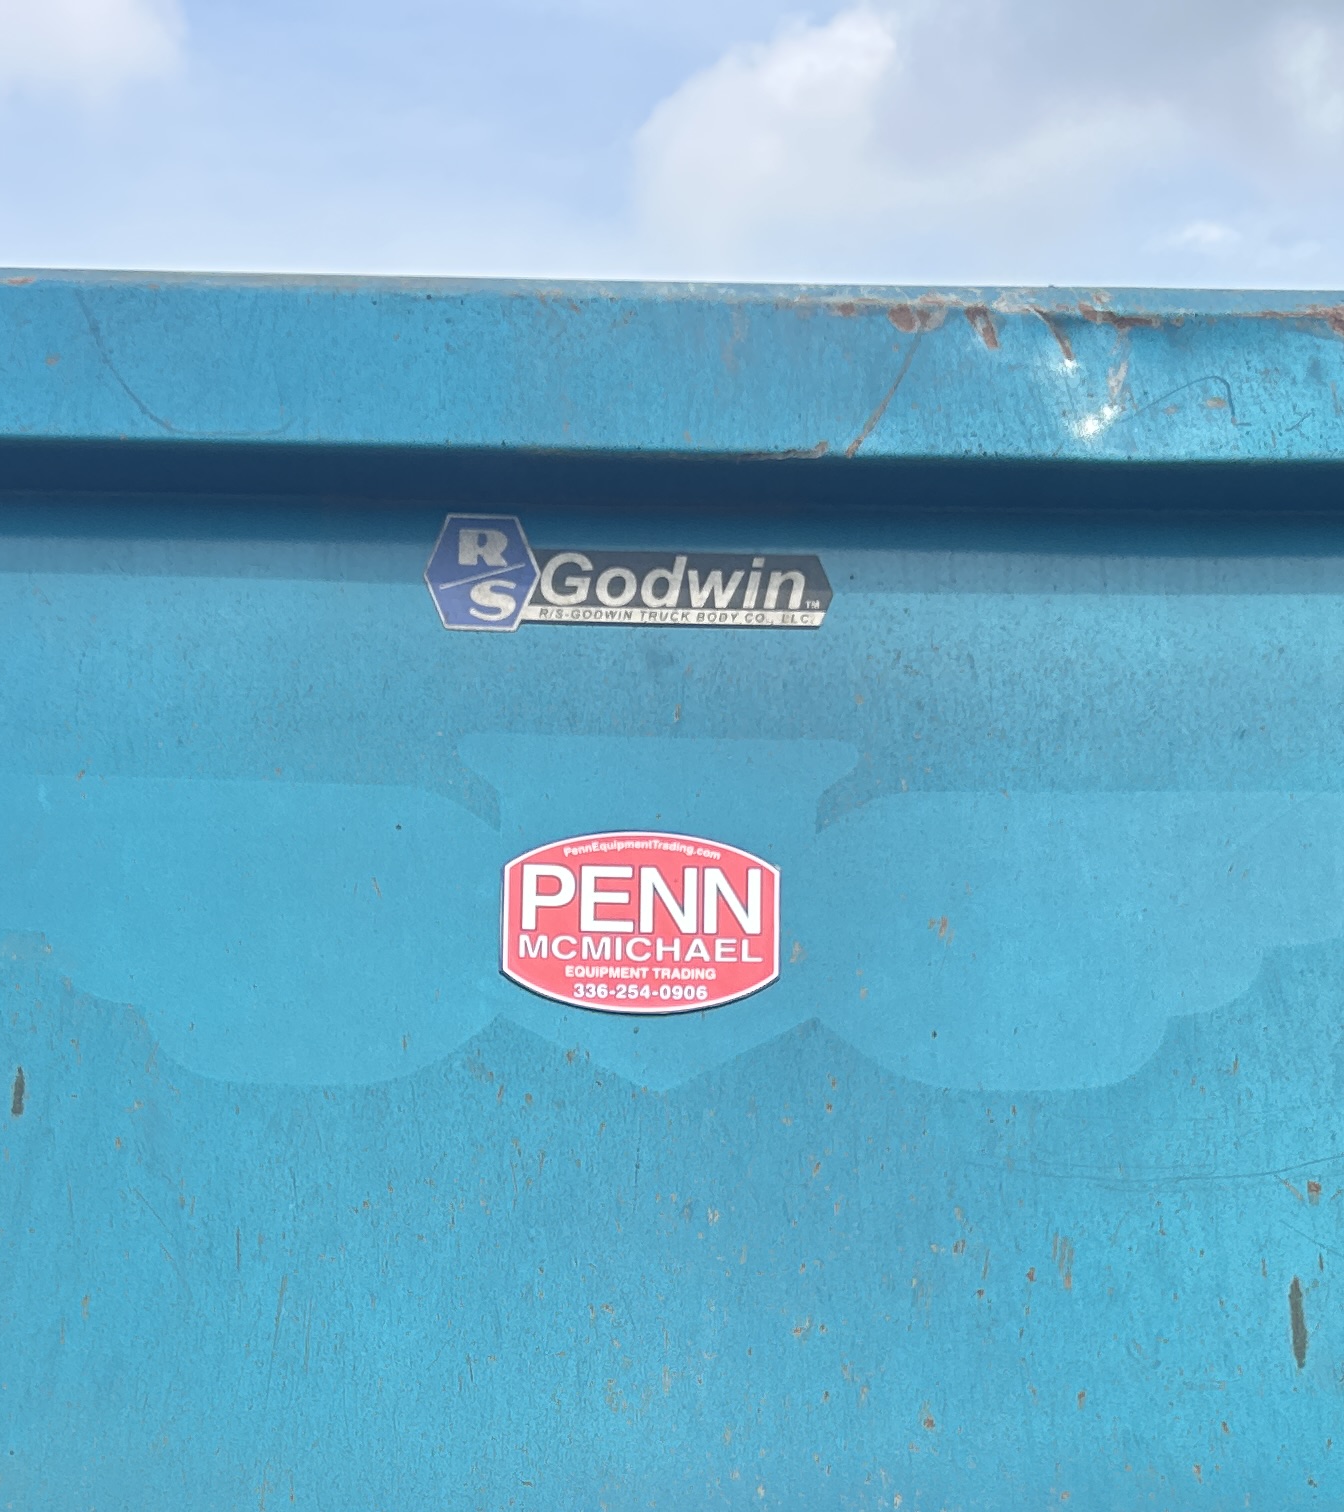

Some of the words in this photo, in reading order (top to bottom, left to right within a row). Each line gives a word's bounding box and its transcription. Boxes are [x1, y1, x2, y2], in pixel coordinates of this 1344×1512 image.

[458, 528, 508, 568] R
[539, 552, 807, 610] Godwin
[469, 579, 517, 621] S
[539, 607, 633, 621] R/S-GODWIN
[640, 610, 690, 622] TRUCK
[696, 611, 739, 624] BODY
[563, 839, 721, 861] PennEquipmentTrading.com
[520, 863, 762, 935] PENN
[517, 934, 763, 963] MCMICHAEL
[564, 965, 649, 979] EQUIPMENT
[652, 967, 717, 980] TRADING
[572, 983, 708, 1000] 336-254-0906
